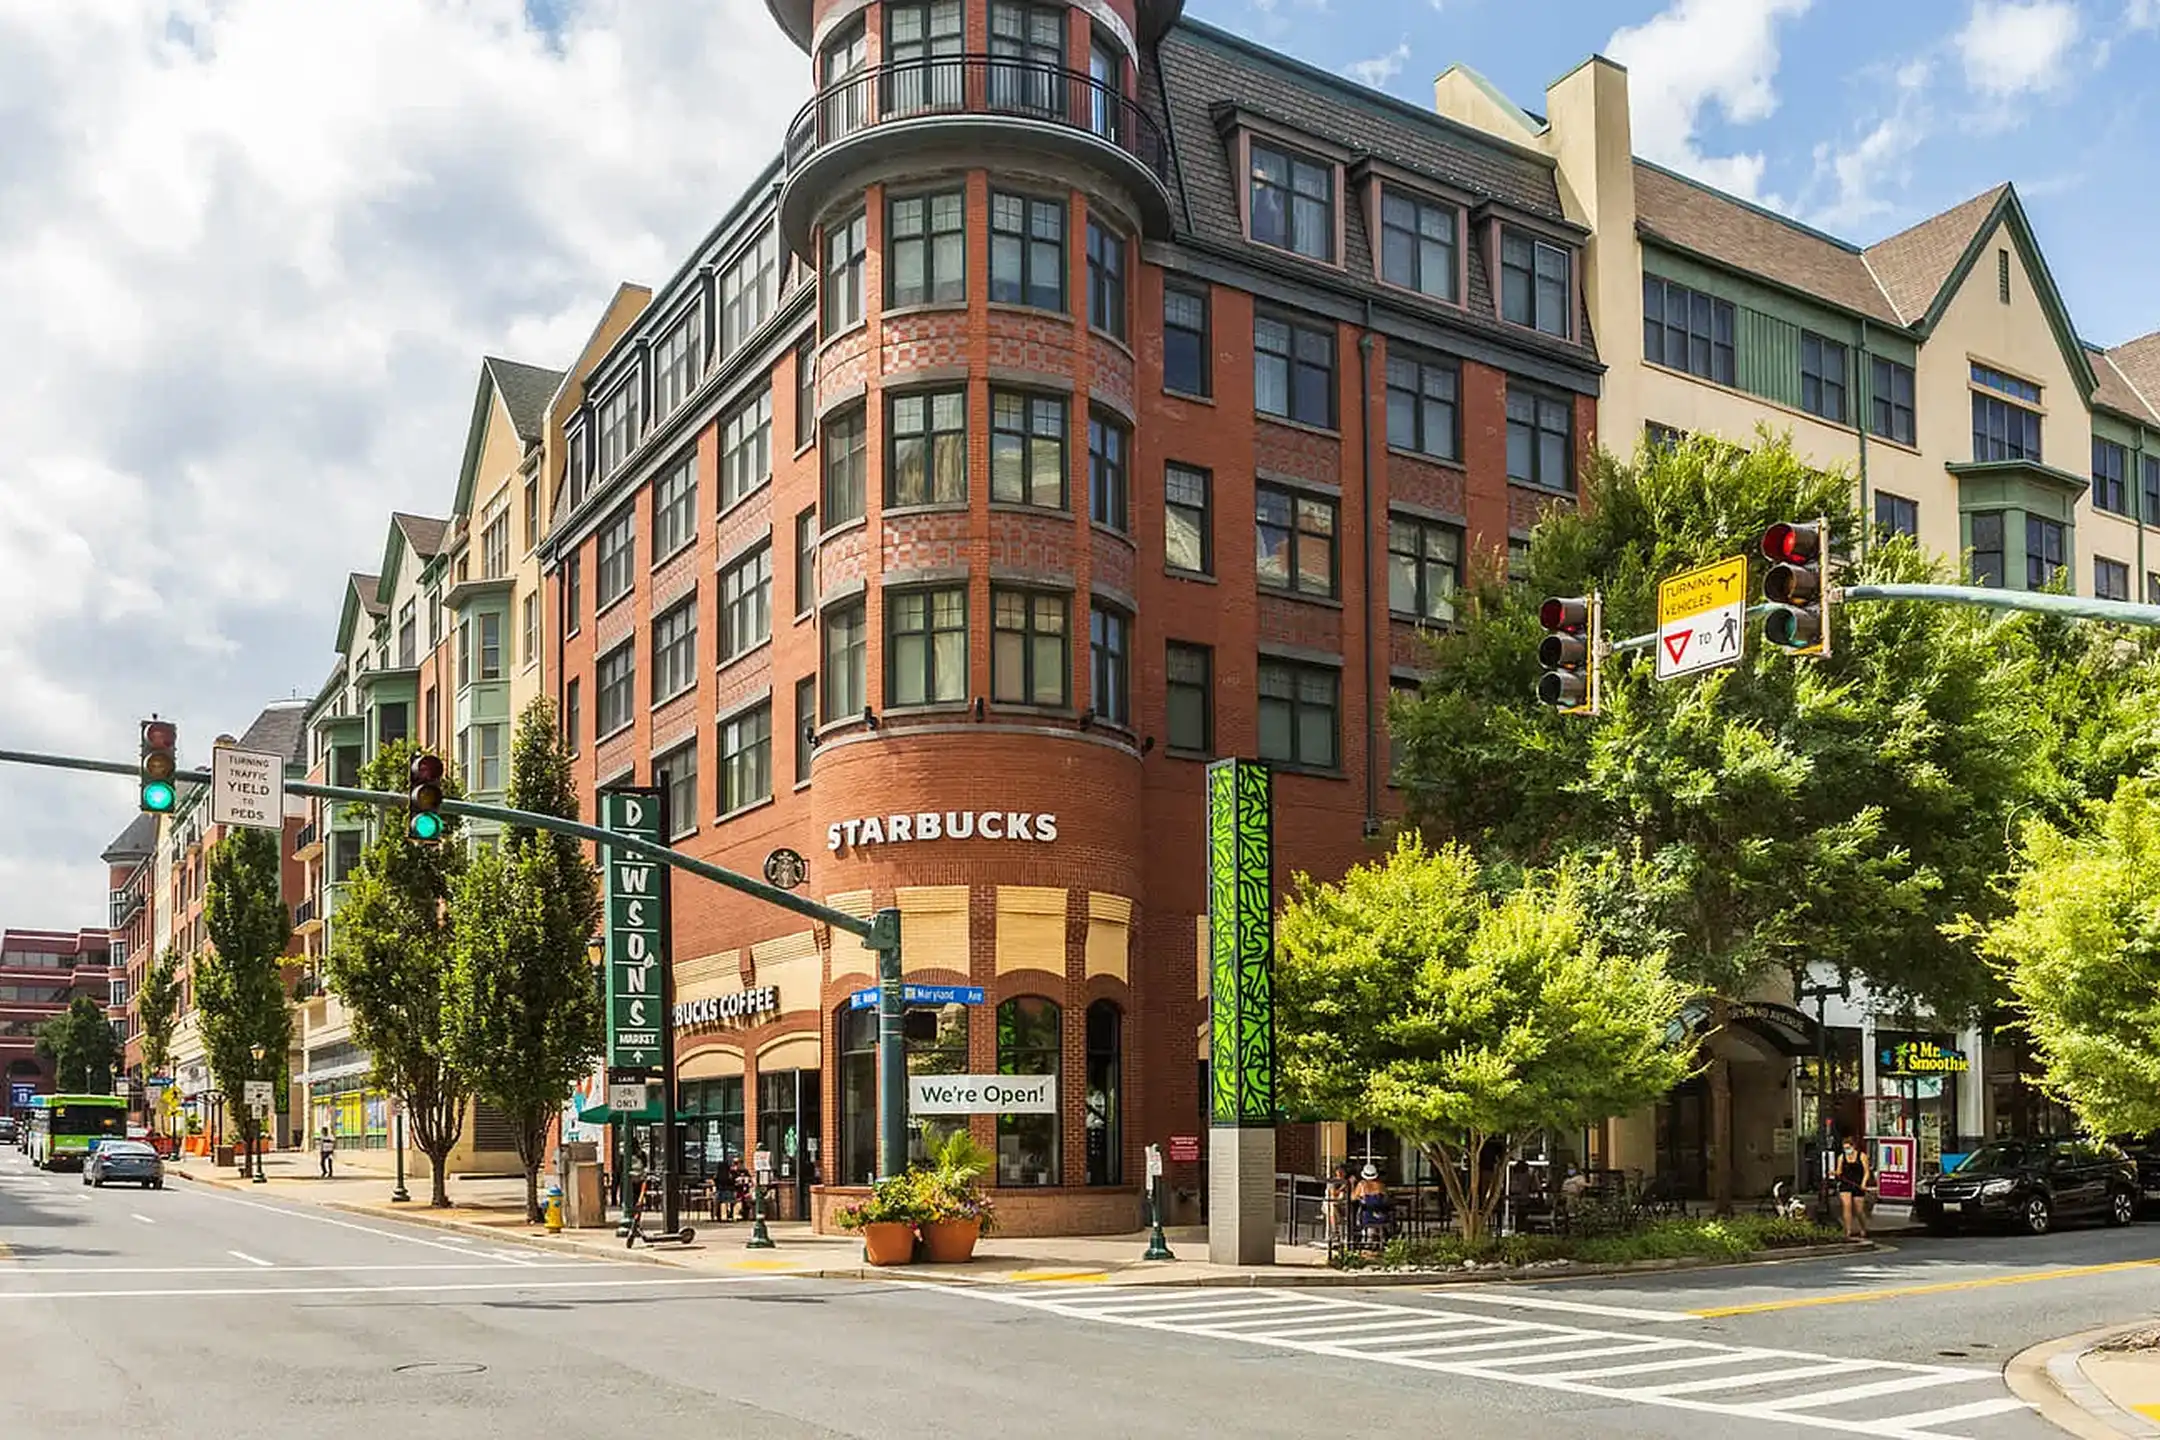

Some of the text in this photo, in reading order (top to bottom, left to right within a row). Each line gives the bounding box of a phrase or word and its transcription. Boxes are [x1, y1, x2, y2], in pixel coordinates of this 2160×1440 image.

[1666, 574, 1714, 598] TURNING
[1665, 593, 1712, 616] VEHICLES
[1698, 632, 1712, 646] TO
[229, 755, 269, 768] TURNING
[230, 768, 267, 781] TRAFFIC
[228, 781, 269, 796] YIELD
[231, 808, 264, 821] PEDS
[827, 811, 1057, 850] STARBUCKS
[720, 985, 775, 1018] COFFEE
[917, 990, 954, 1001] Maryland
[619, 1034, 656, 1045] MARKET
[1920, 1041, 1941, 1057] Mr.
[1908, 1054, 1969, 1072] Smoothie
[921, 1085, 1044, 1106] We're Open!
[616, 1099, 638, 1109] ONLY
